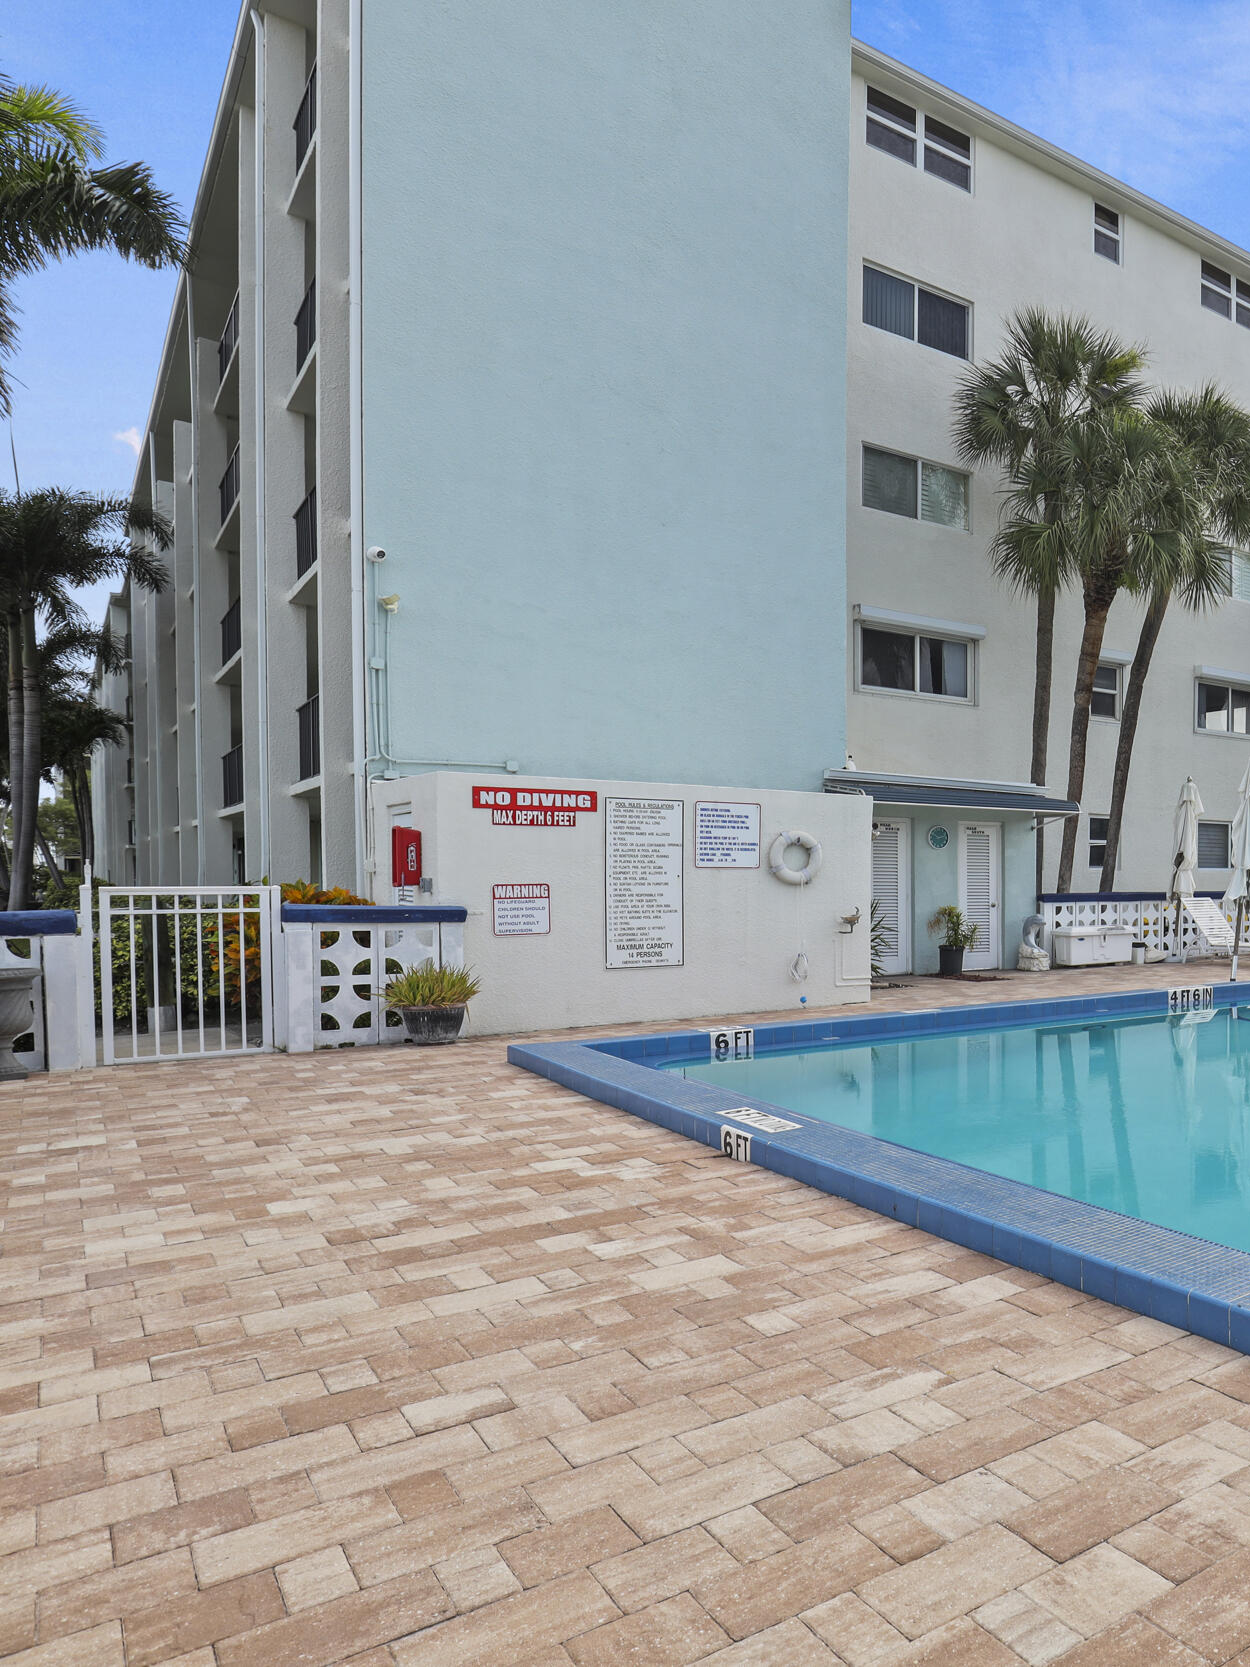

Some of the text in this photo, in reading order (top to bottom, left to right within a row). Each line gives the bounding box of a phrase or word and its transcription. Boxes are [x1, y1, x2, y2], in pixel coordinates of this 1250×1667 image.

[480, 791, 591, 807] NO DIVING
[493, 810, 574, 825] MAX DEPTH 6 FEET
[495, 885, 549, 898] WARNING
[1170, 987, 1212, 1001] 4 FT 6 IN
[715, 1030, 751, 1049] 6 FT
[723, 1130, 749, 1162] 6 FT
